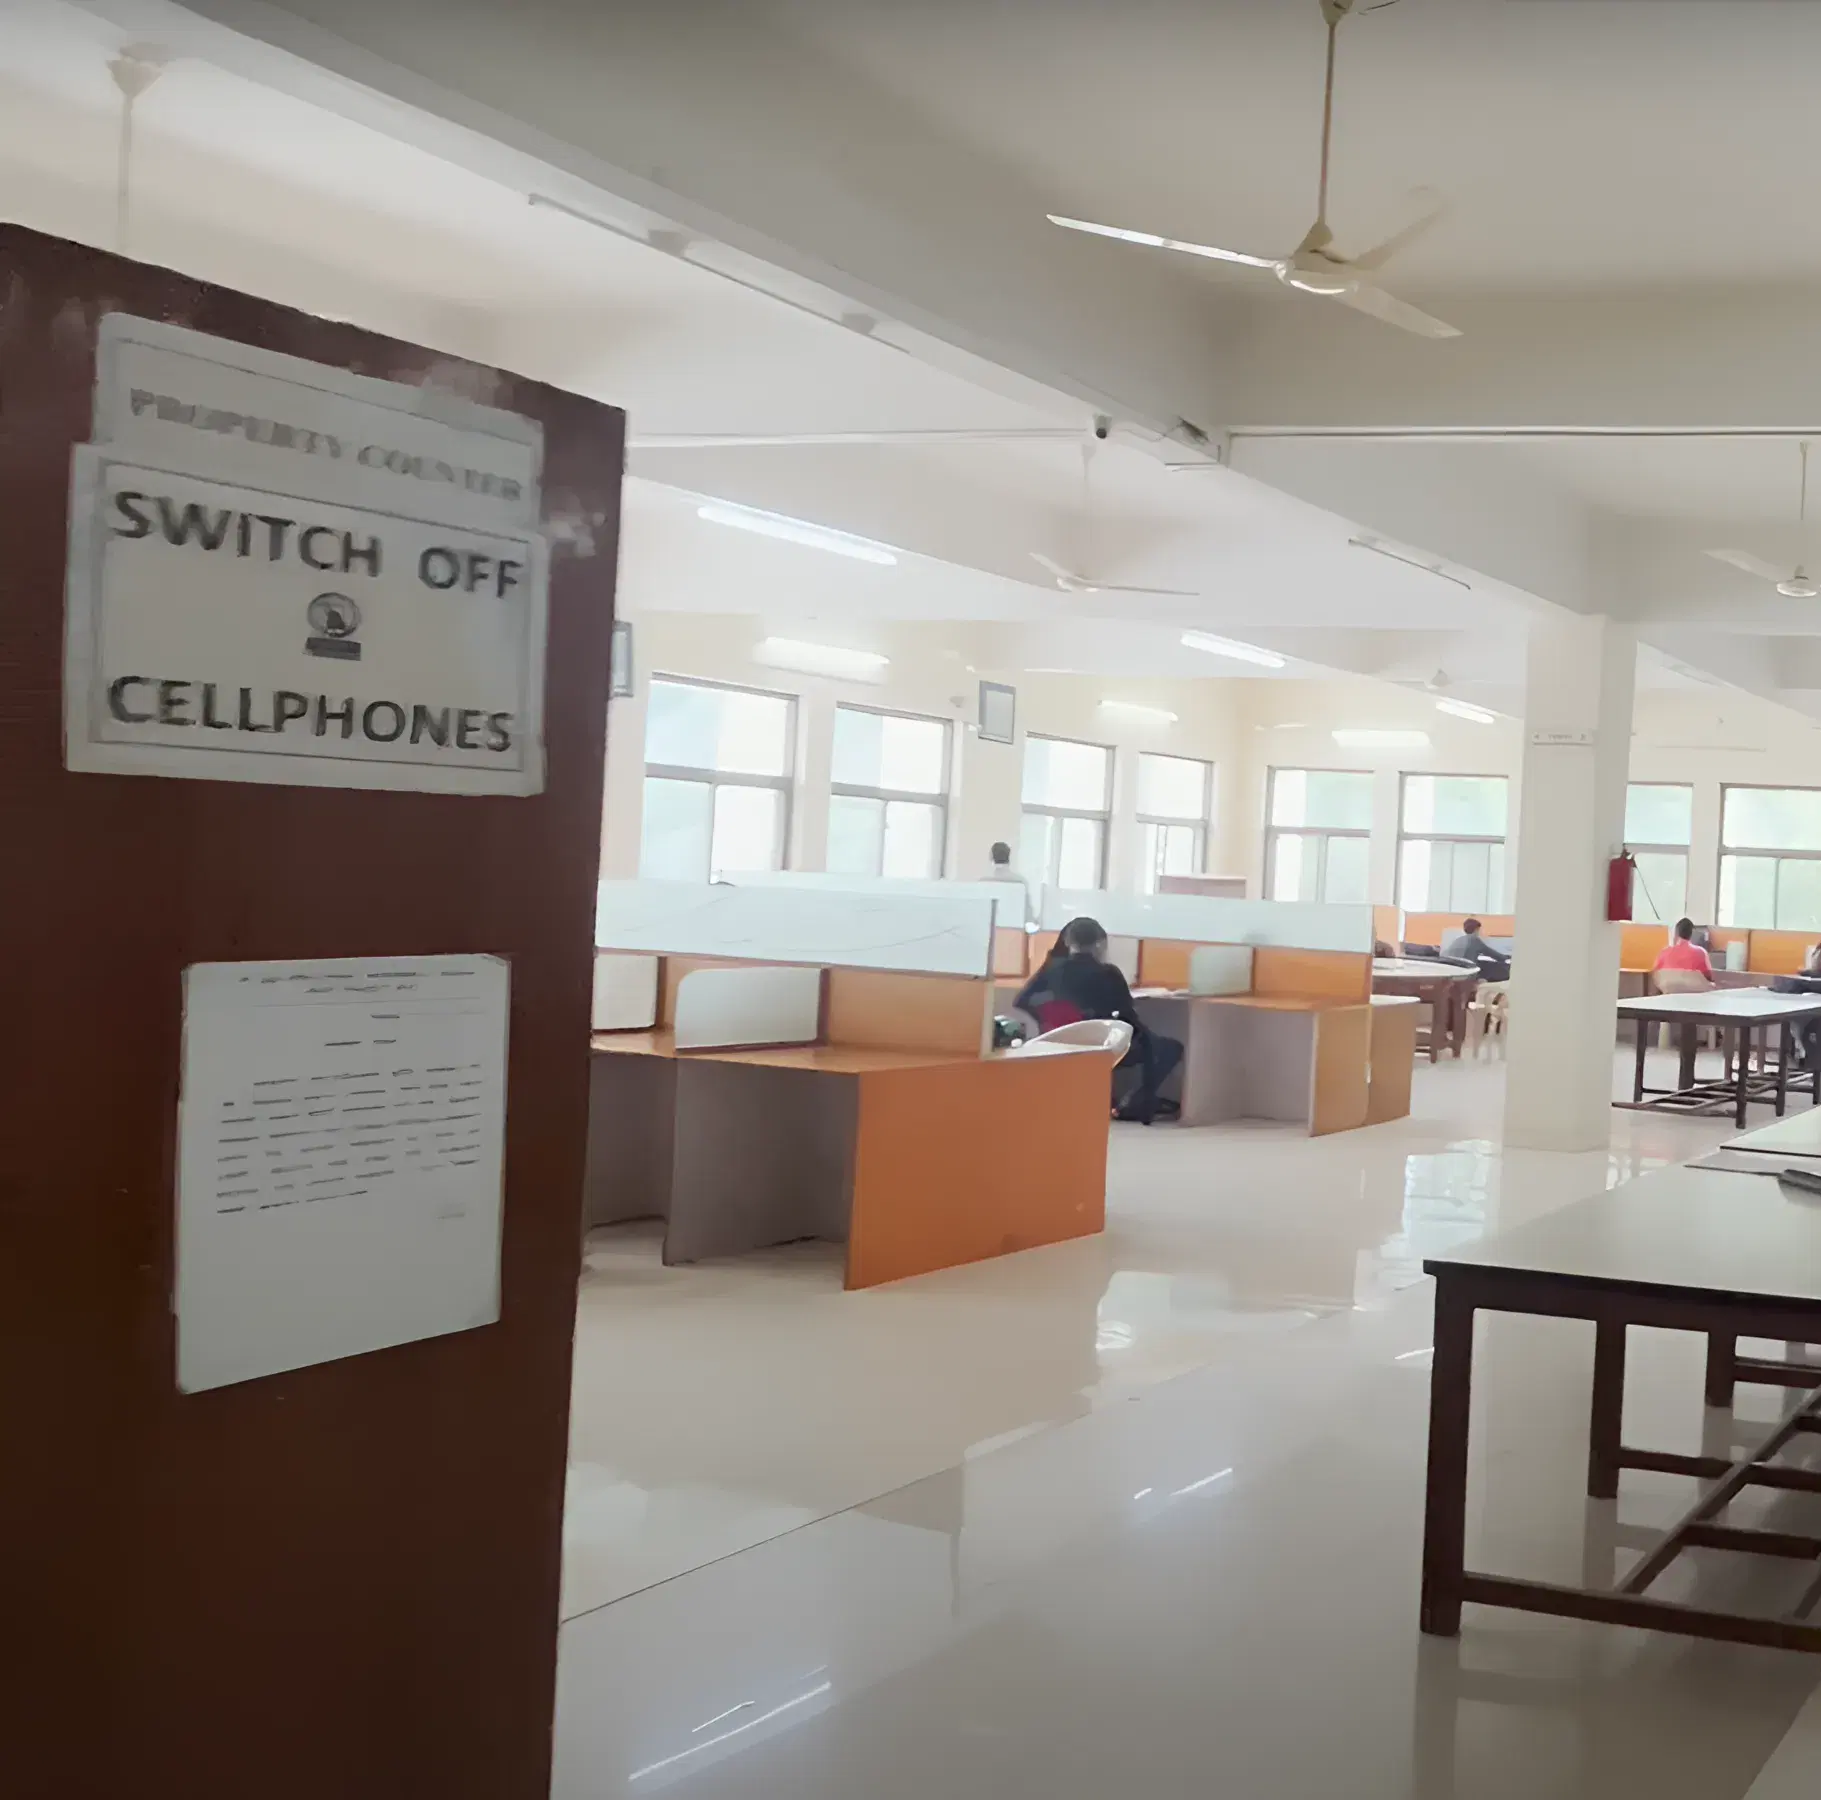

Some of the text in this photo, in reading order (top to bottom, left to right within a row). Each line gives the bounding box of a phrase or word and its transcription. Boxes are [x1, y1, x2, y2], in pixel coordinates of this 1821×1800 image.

[357, 445, 523, 501] COUNTER
[112, 491, 523, 598] SWITCH OFF
[108, 675, 513, 752] CELLPHONES
